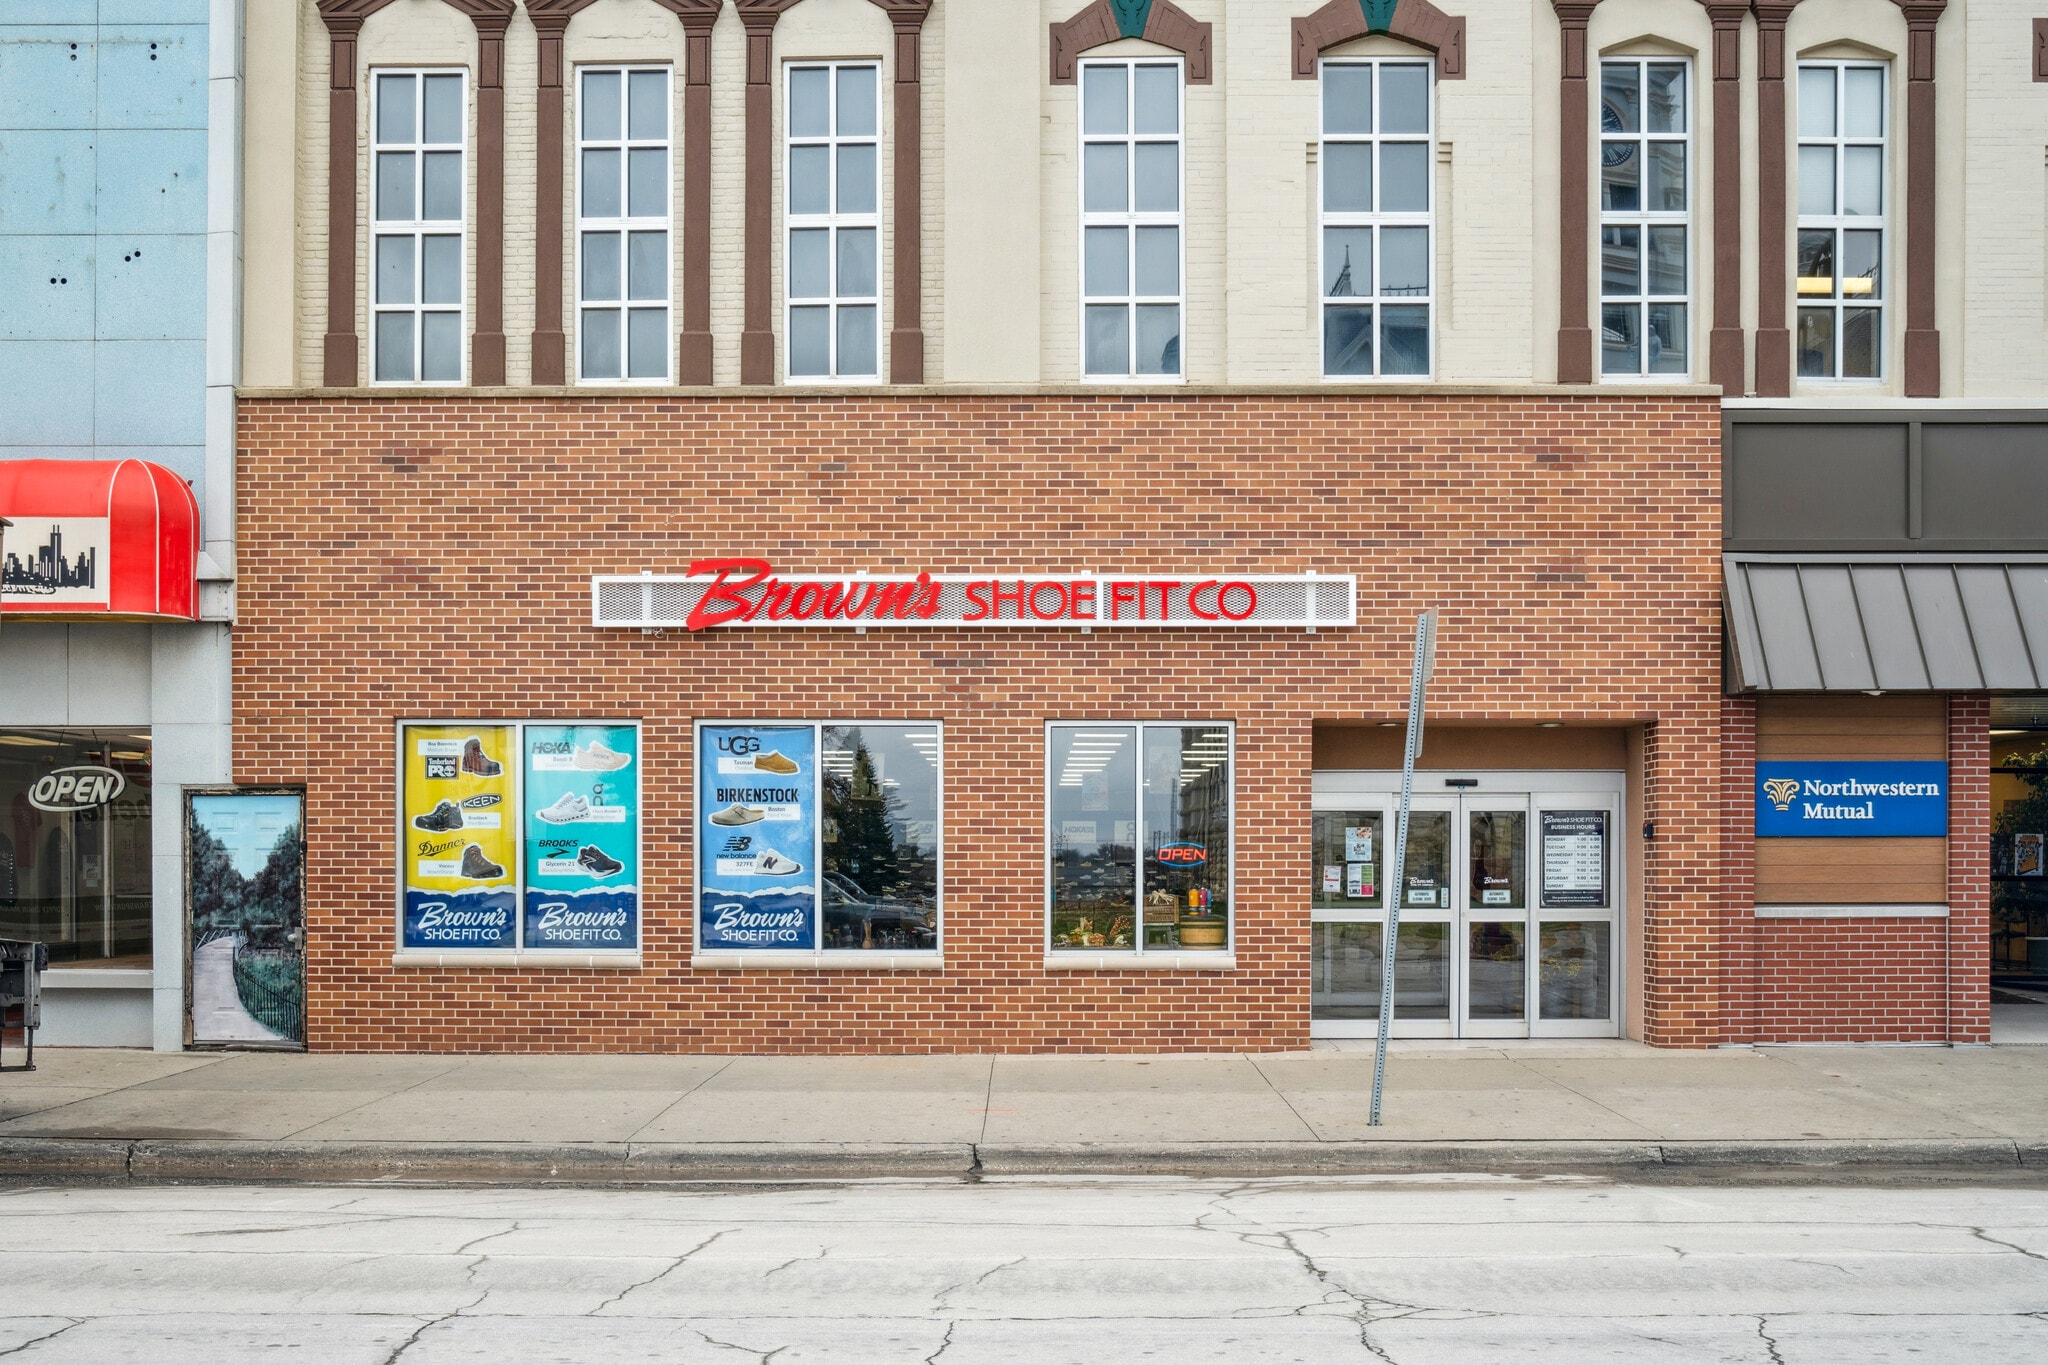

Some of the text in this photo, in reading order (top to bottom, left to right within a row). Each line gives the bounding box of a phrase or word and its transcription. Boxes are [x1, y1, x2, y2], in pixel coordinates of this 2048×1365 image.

[685, 558, 1257, 631] Brown's SHOE FIT CO
[531, 742, 571, 754] HOKA
[718, 736, 760, 755] UGG
[35, 775, 115, 803] OPEN
[716, 788, 799, 802] BIRKENSTOCK
[1803, 778, 1940, 797] Northwestern
[463, 796, 500, 808] KEEN
[1803, 802, 1874, 820] Mutual
[417, 839, 465, 857] Danner
[1158, 848, 1207, 861] OPEN
[417, 902, 507, 930] Brown's
[538, 902, 627, 930] Brown's
[712, 903, 804, 930] Brown's
[424, 928, 502, 940] SHOE FIT CO.
[544, 928, 622, 940] SHOE FIT CO.
[720, 929, 798, 942] SHOE FIT CO.
